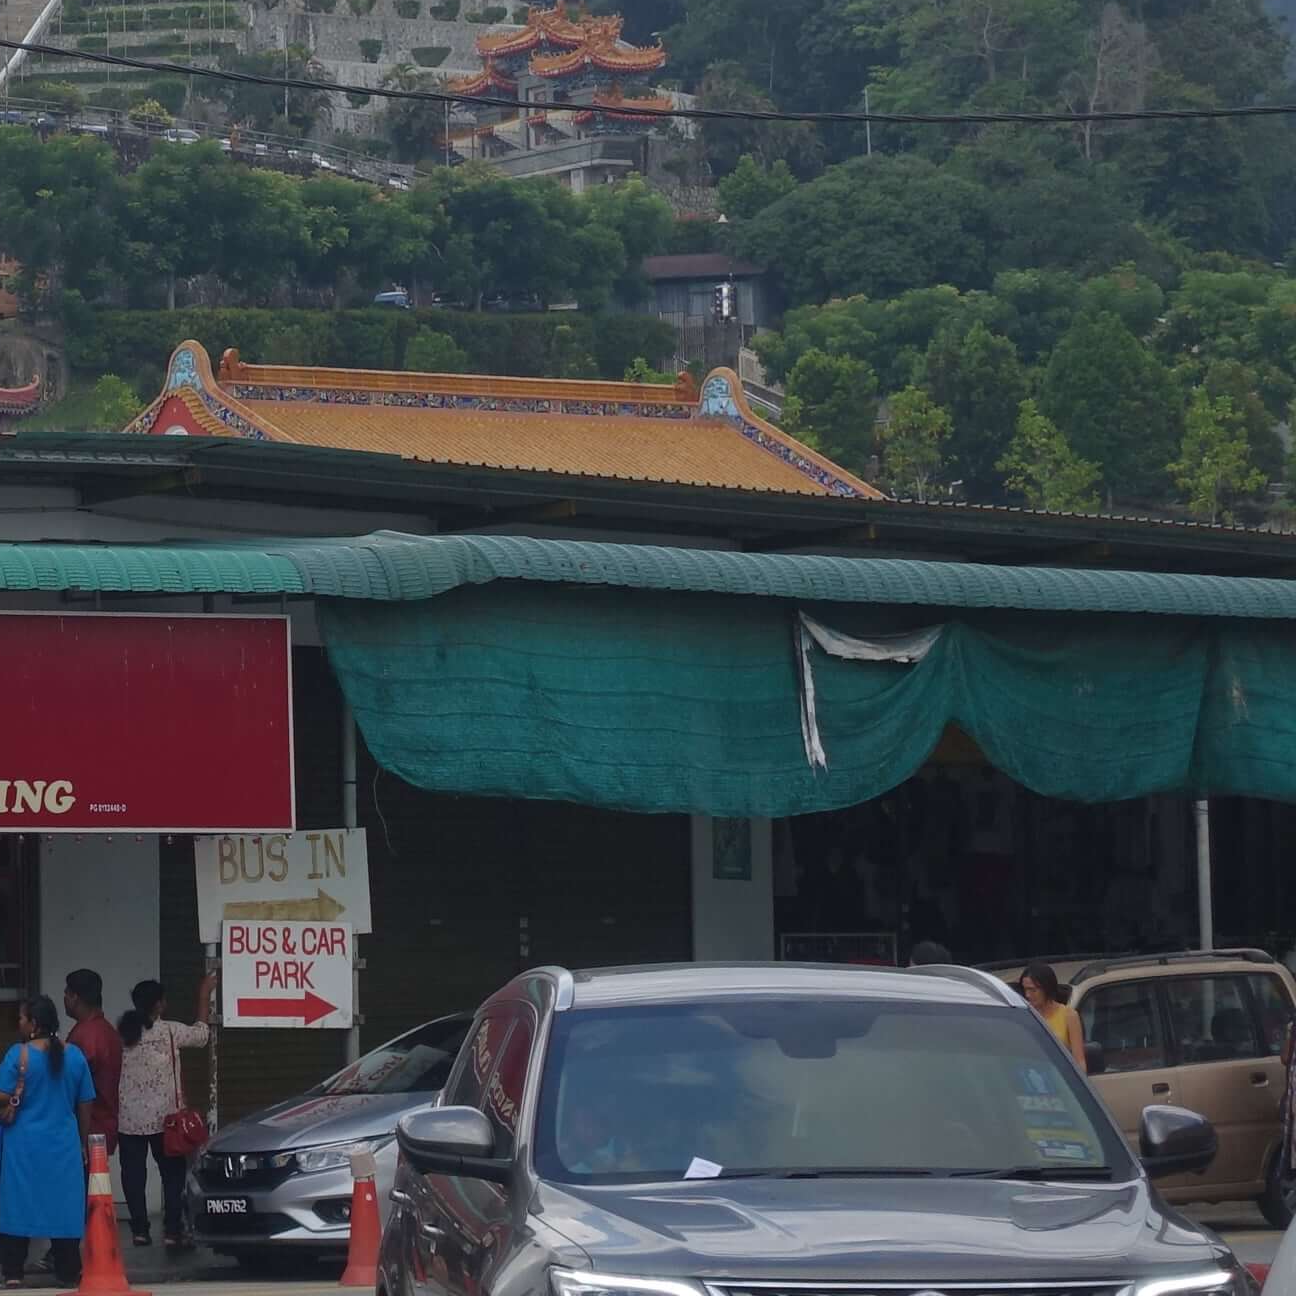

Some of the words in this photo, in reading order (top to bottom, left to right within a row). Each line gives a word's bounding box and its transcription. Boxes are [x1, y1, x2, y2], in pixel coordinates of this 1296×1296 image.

[218, 836, 289, 885] BUS
[305, 833, 346, 880] IN
[229, 926, 277, 954] BUS
[282, 926, 296, 955] &
[301, 926, 346, 956] CAR
[255, 960, 315, 990] PARK
